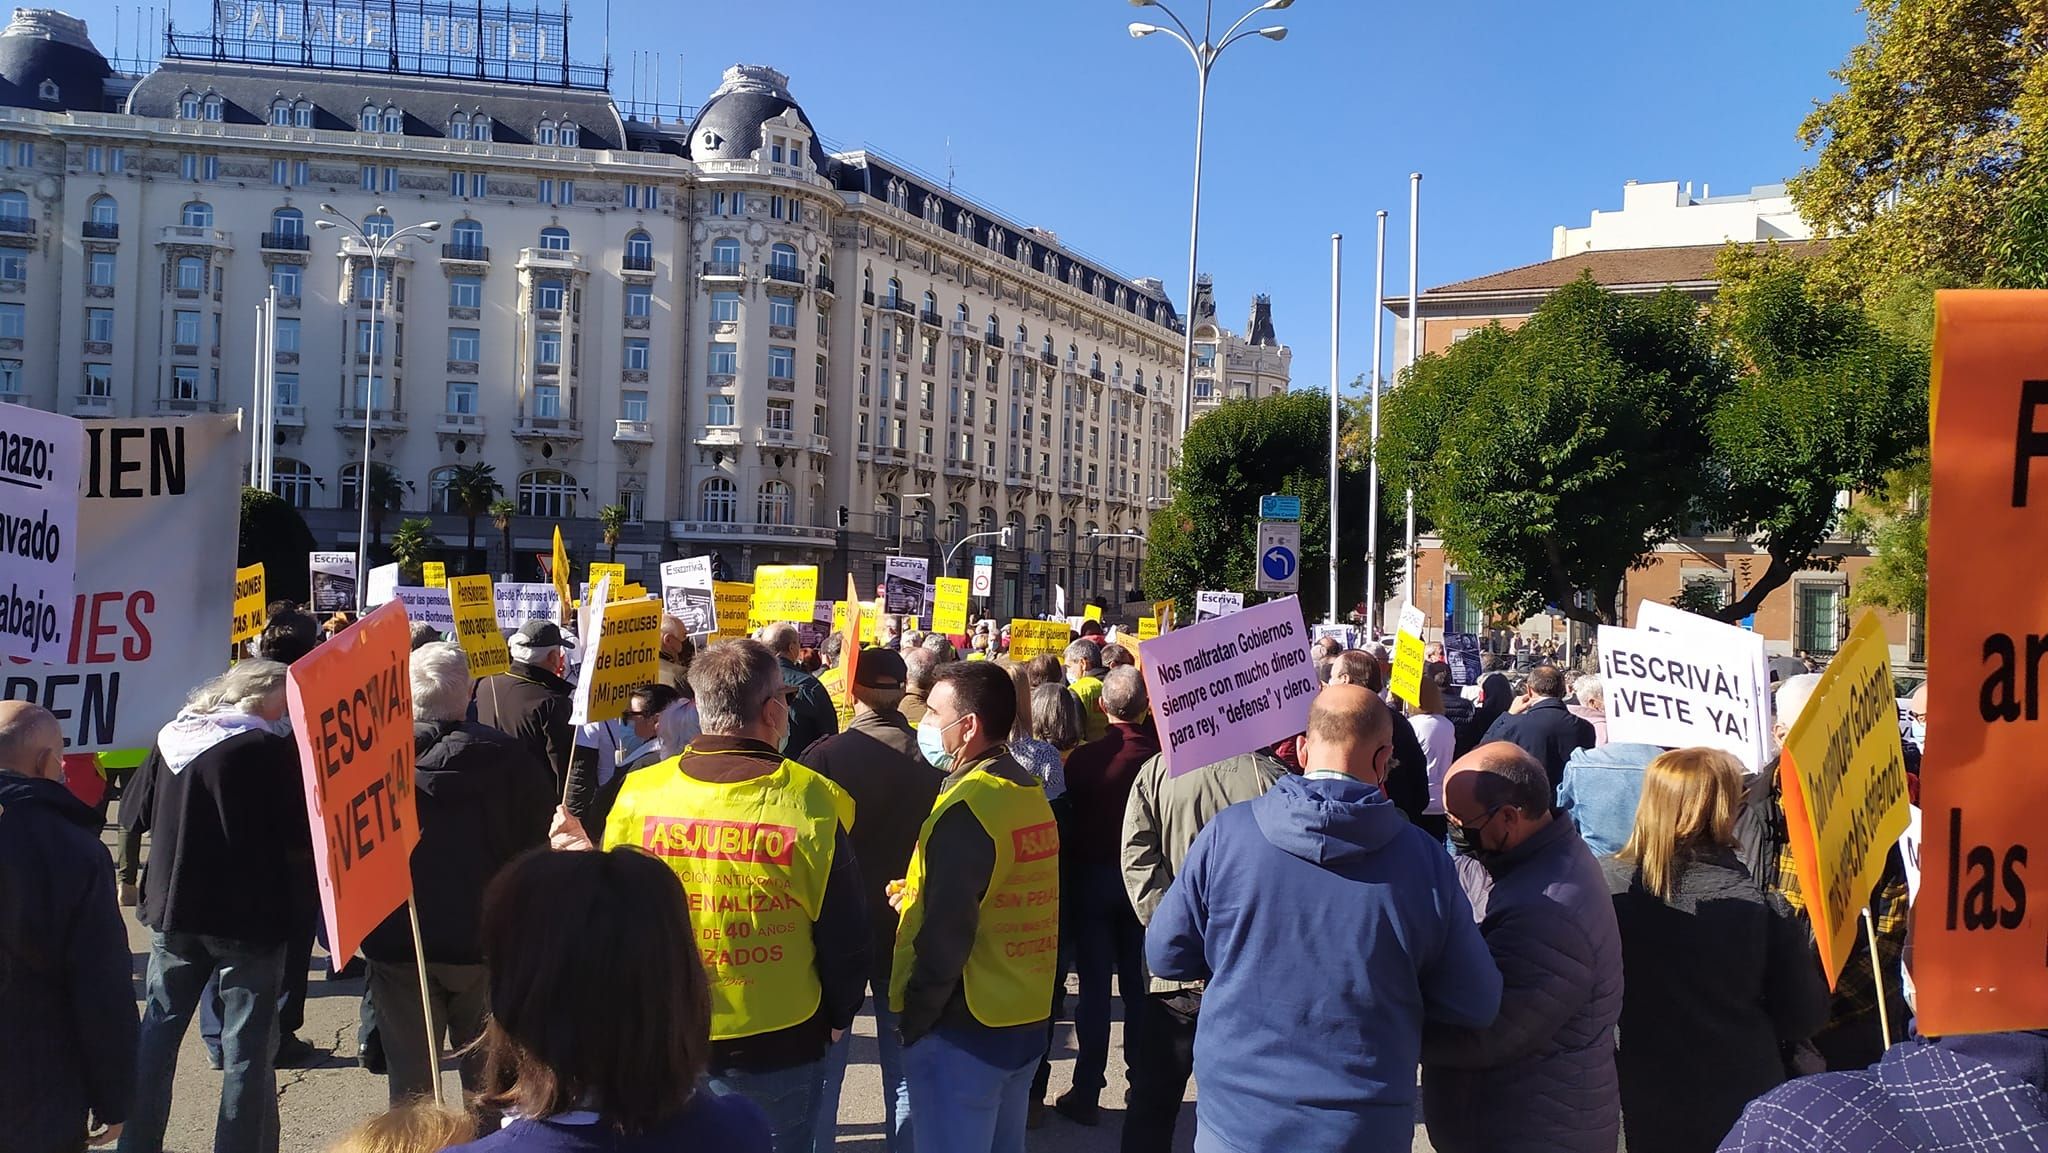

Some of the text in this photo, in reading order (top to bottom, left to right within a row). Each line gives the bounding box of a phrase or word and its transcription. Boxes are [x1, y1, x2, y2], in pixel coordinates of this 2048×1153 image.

[219, 0, 560, 61] PALACE HOTEL
[496, 588, 515, 601] Desde
[516, 588, 543, 602] Podemos
[497, 606, 515, 621] exijo
[516, 607, 526, 618] mi
[600, 615, 657, 637] Sin excusas
[1157, 621, 1294, 685] Nos maltratan Gobiernos
[597, 641, 656, 670] de ladrón:
[1162, 648, 1306, 717] siempre con mucho dinero
[1605, 650, 1749, 708] ¡ESCRIVÀ!,
[1169, 678, 1315, 752] para rey, "defensa" y clero.
[1613, 687, 1749, 743] ¡VETE YA!
[1946, 808, 2028, 931] las
[703, 929, 721, 940] DE
[725, 922, 751, 939] 40
